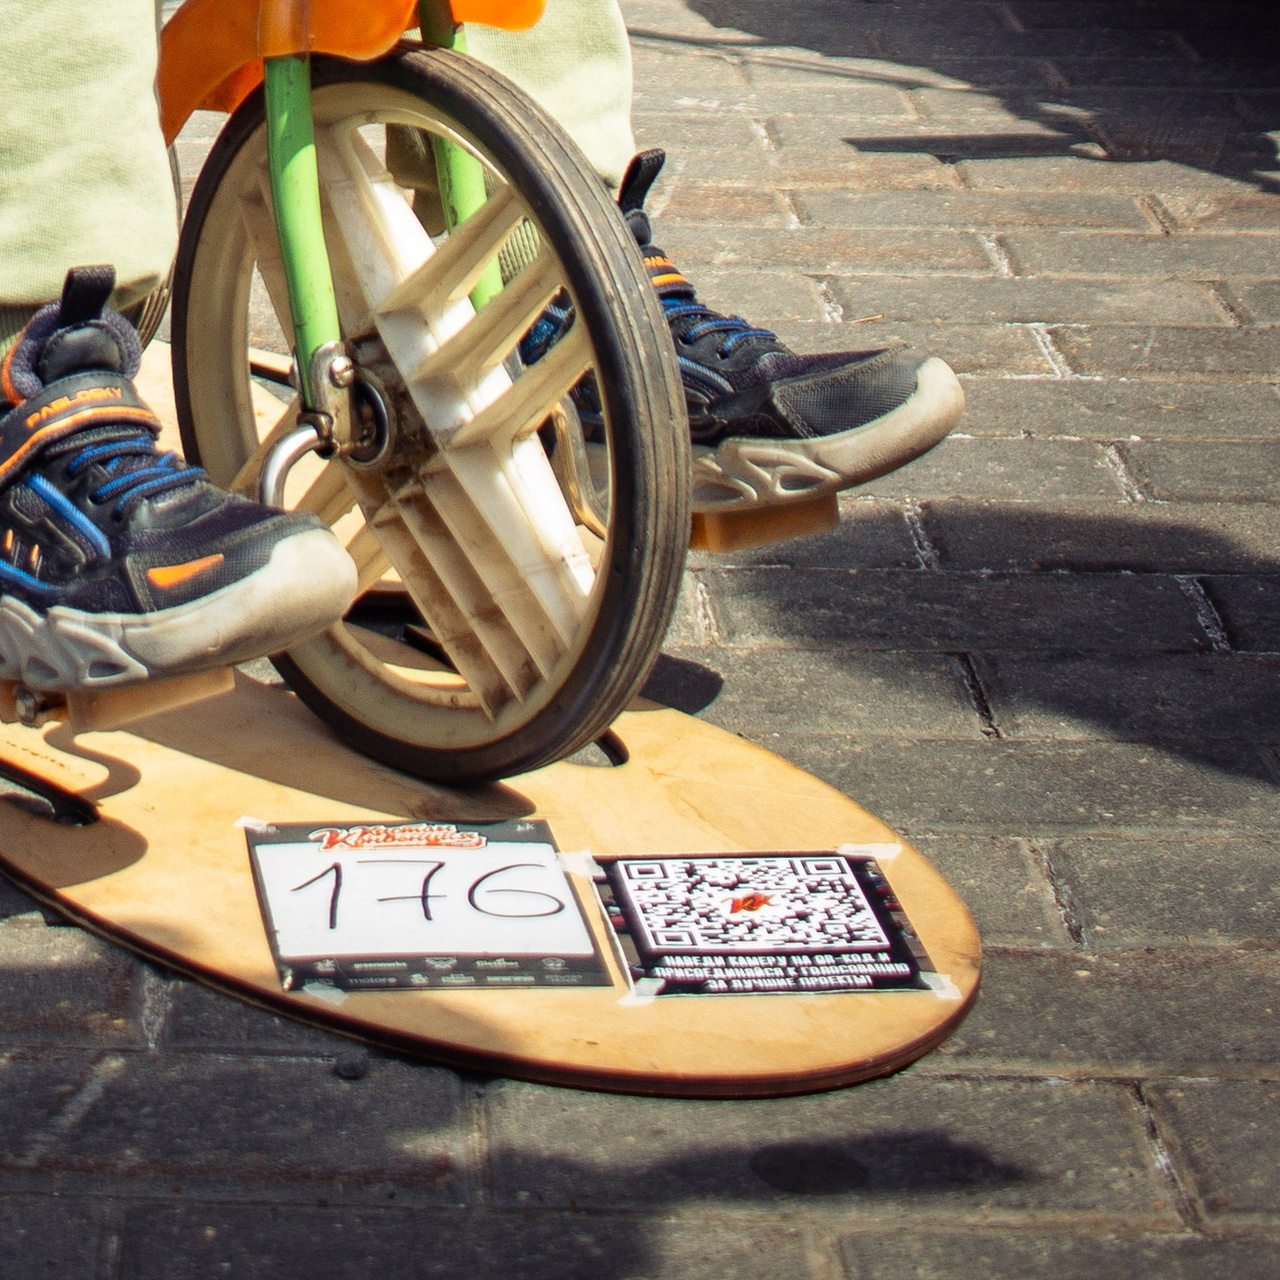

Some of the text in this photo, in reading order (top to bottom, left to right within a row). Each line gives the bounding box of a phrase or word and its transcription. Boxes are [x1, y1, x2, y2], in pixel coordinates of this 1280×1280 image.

[291, 860, 565, 929] 176
[663, 955, 725, 967] НАВЕДИ
[728, 955, 787, 967] КАМЕРУ
[790, 955, 812, 967] НА
[877, 952, 891, 963] И
[654, 963, 911, 979] ПРИСОЕДИНЯЙСЯ К ГОЛОСОВАНИЮ
[705, 975, 873, 990] ЗА ЛУЧШИЕ ПРОЕКТЫ!
